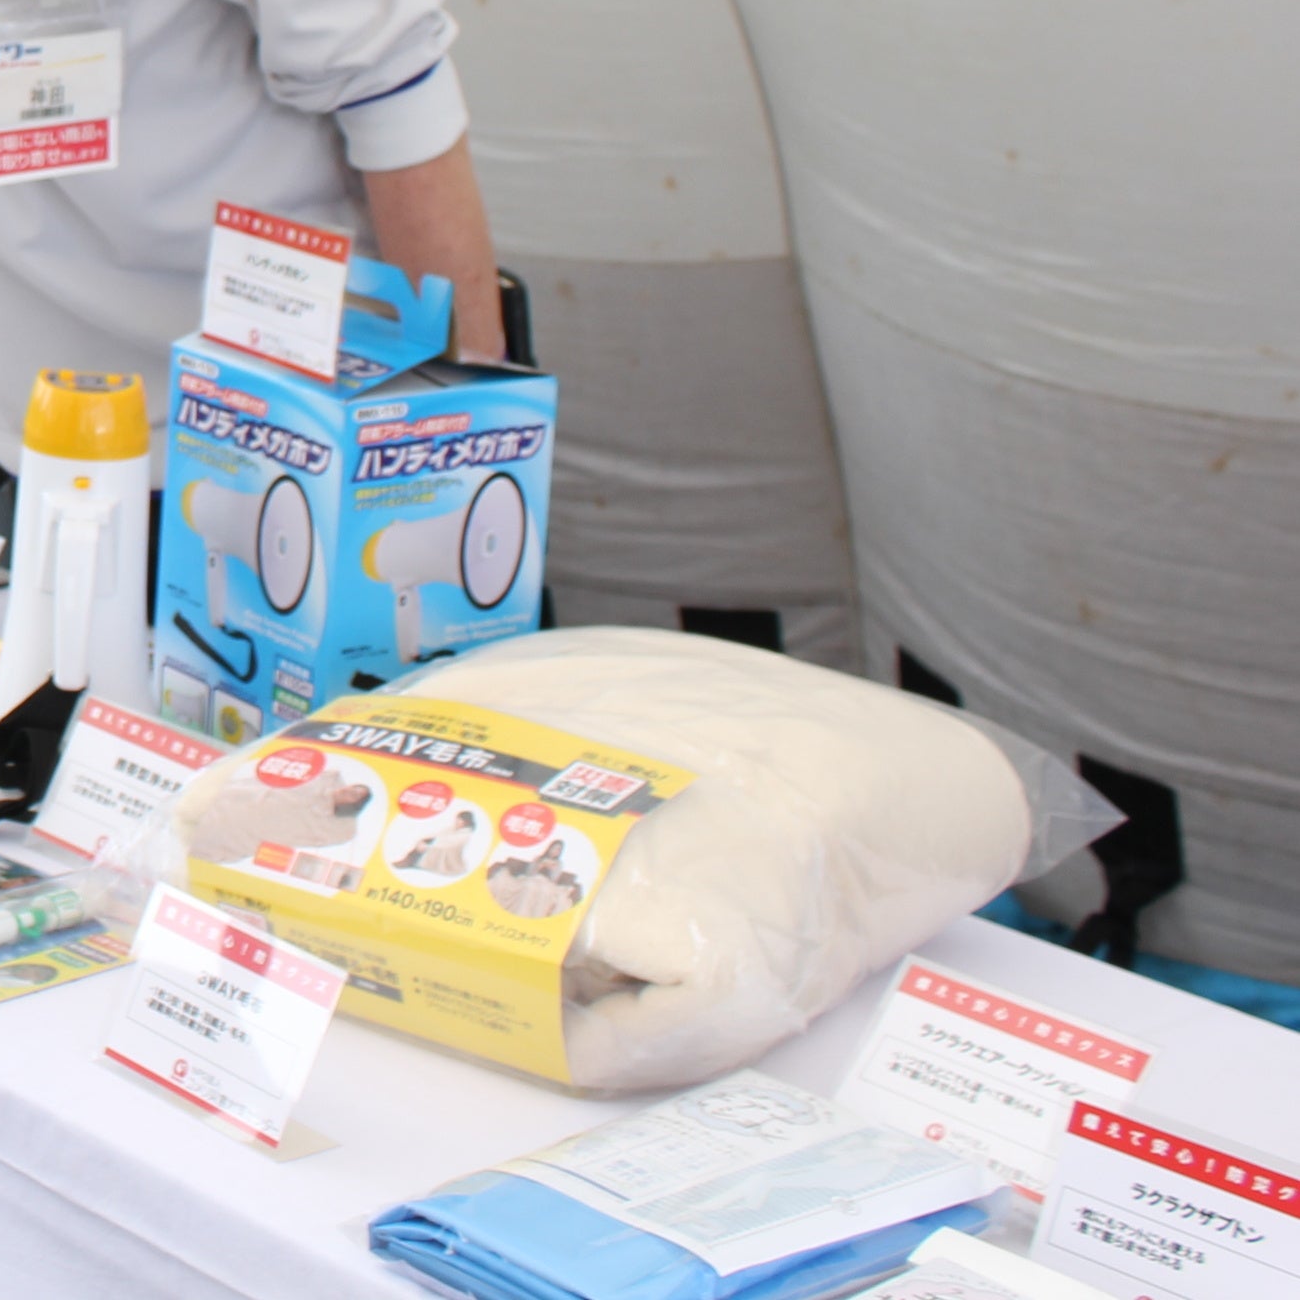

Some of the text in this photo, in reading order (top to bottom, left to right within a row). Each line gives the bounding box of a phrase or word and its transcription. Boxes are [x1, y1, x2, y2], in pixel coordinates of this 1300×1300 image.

[177, 396, 333, 475] ハンディメガホン
[354, 428, 544, 482] ハンディメガホン
[320, 723, 497, 771] 3WAY毛布
[913, 974, 1137, 1070] 備えて安心！防災グッズ
[919, 1022, 1086, 1098] ラクラクエアークッション
[1080, 1111, 1298, 1202] 備えて安心！防災グ
[1130, 1182, 1265, 1245] ラクラクザブトン
